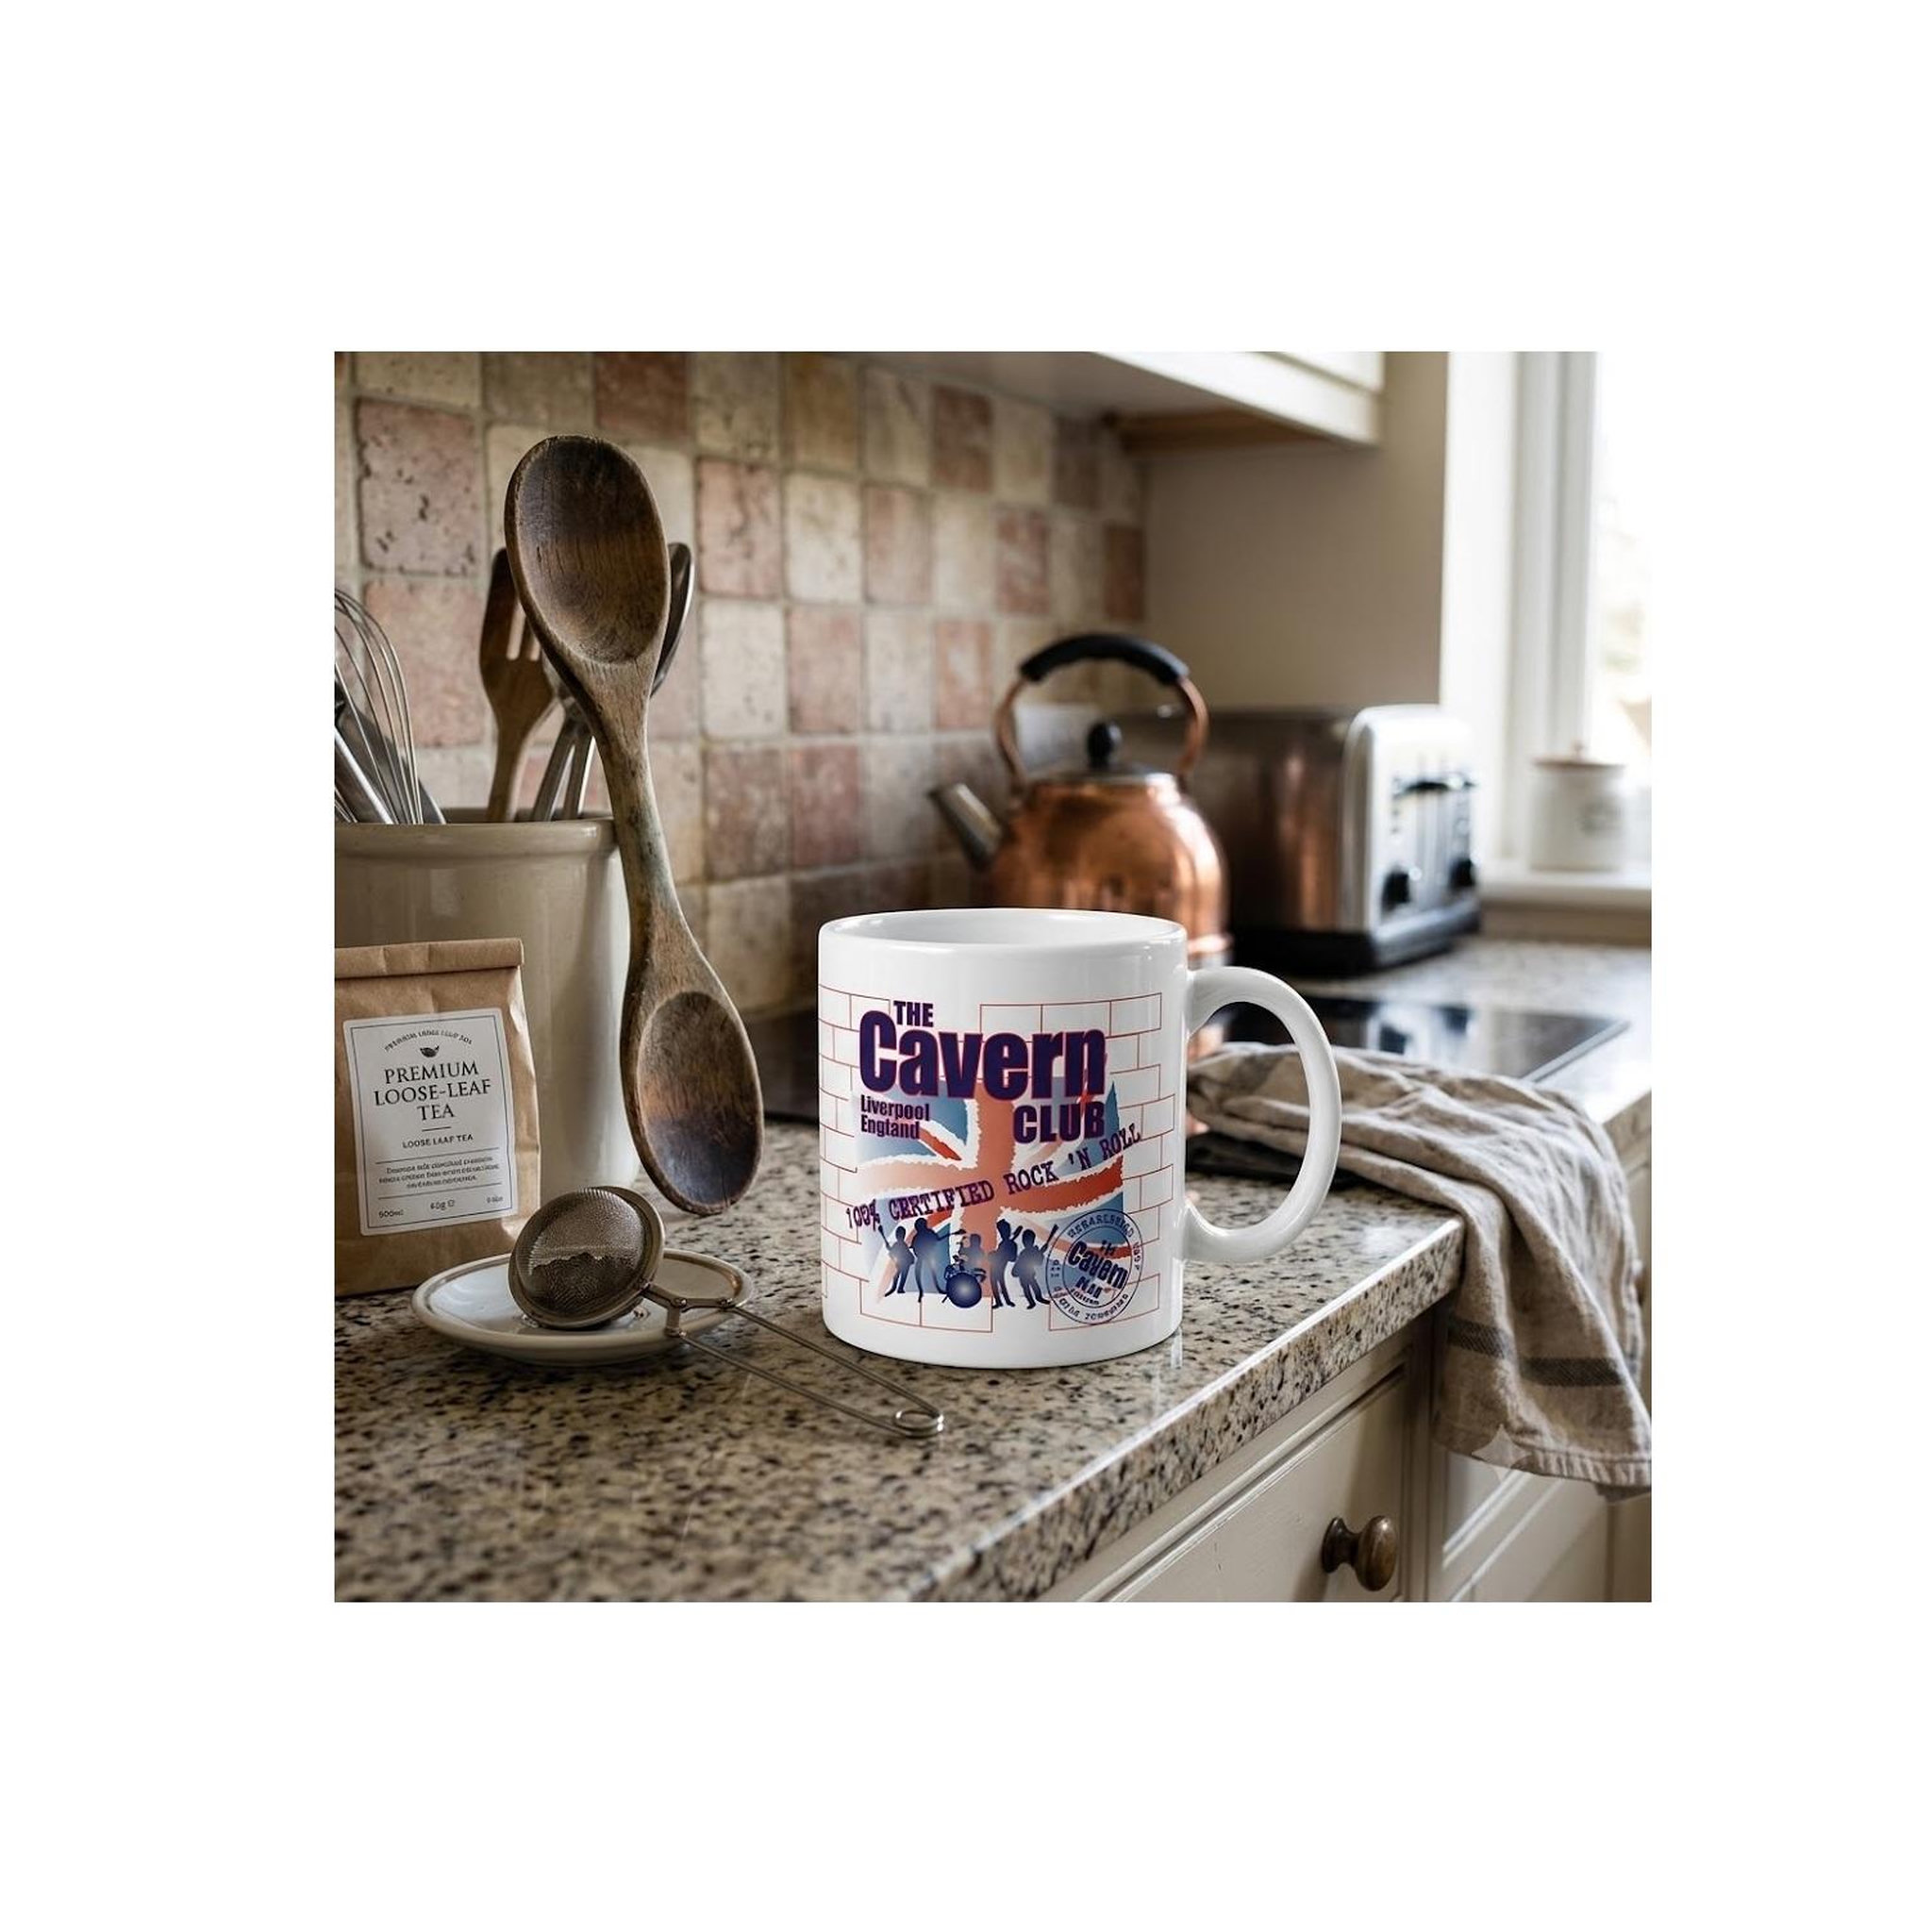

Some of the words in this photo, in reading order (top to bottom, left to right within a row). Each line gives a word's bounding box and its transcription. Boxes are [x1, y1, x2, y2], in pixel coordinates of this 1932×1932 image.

[893, 1000, 934, 1027] THE
[859, 1009, 1108, 1101] Cavern
[384, 1060, 479, 1085] PREMIUM
[374, 1078, 491, 1107] LOOSE-LEAF
[416, 1103, 455, 1121] TEA
[860, 1094, 930, 1122] Liverpool
[1013, 1101, 1106, 1144] CLUB
[456, 1134, 474, 1142] TEA
[888, 1180, 995, 1221] CERTIFIED
[1003, 1160, 1059, 1195] ROCK
[1099, 1123, 1141, 1160] ROLL
